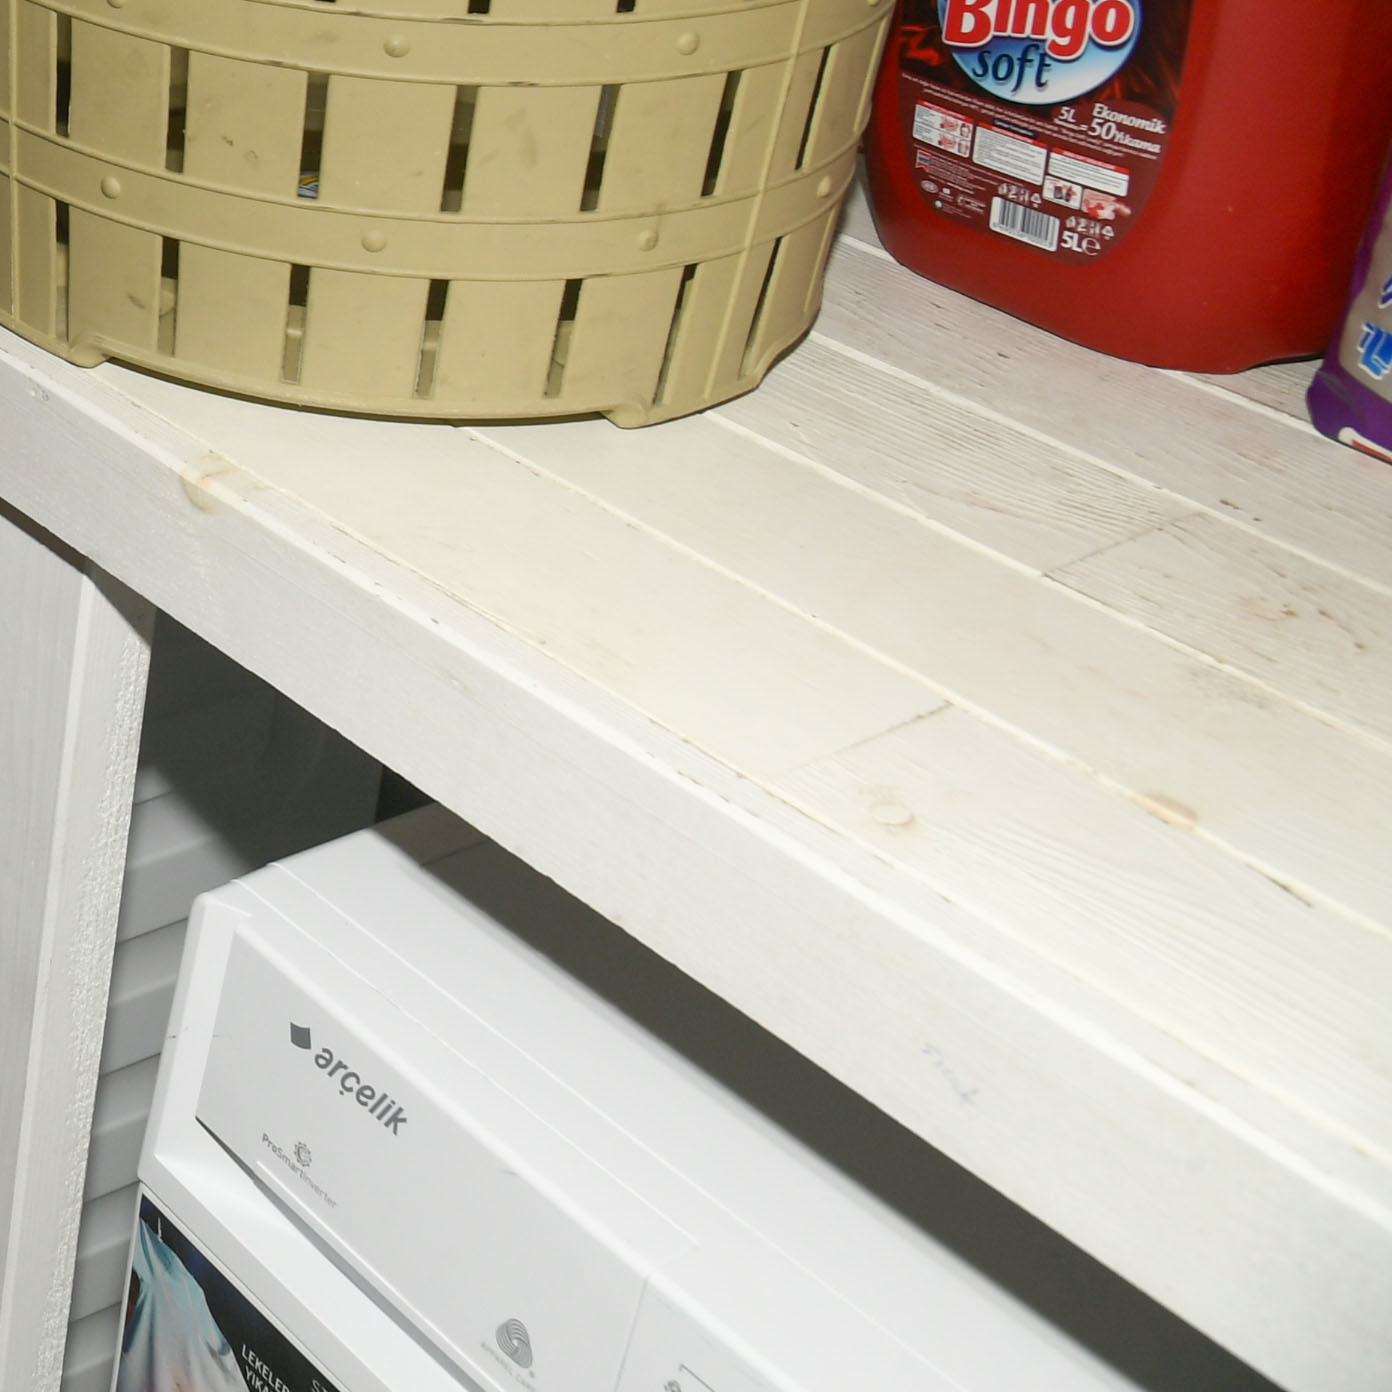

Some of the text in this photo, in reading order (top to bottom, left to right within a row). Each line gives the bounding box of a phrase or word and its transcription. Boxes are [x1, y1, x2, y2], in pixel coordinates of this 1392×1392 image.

[971, 43, 1053, 93] soft
[1058, 106, 1076, 123] 5L
[1092, 102, 1167, 135] Ekonomik
[314, 1047, 407, 1136] arçelik
